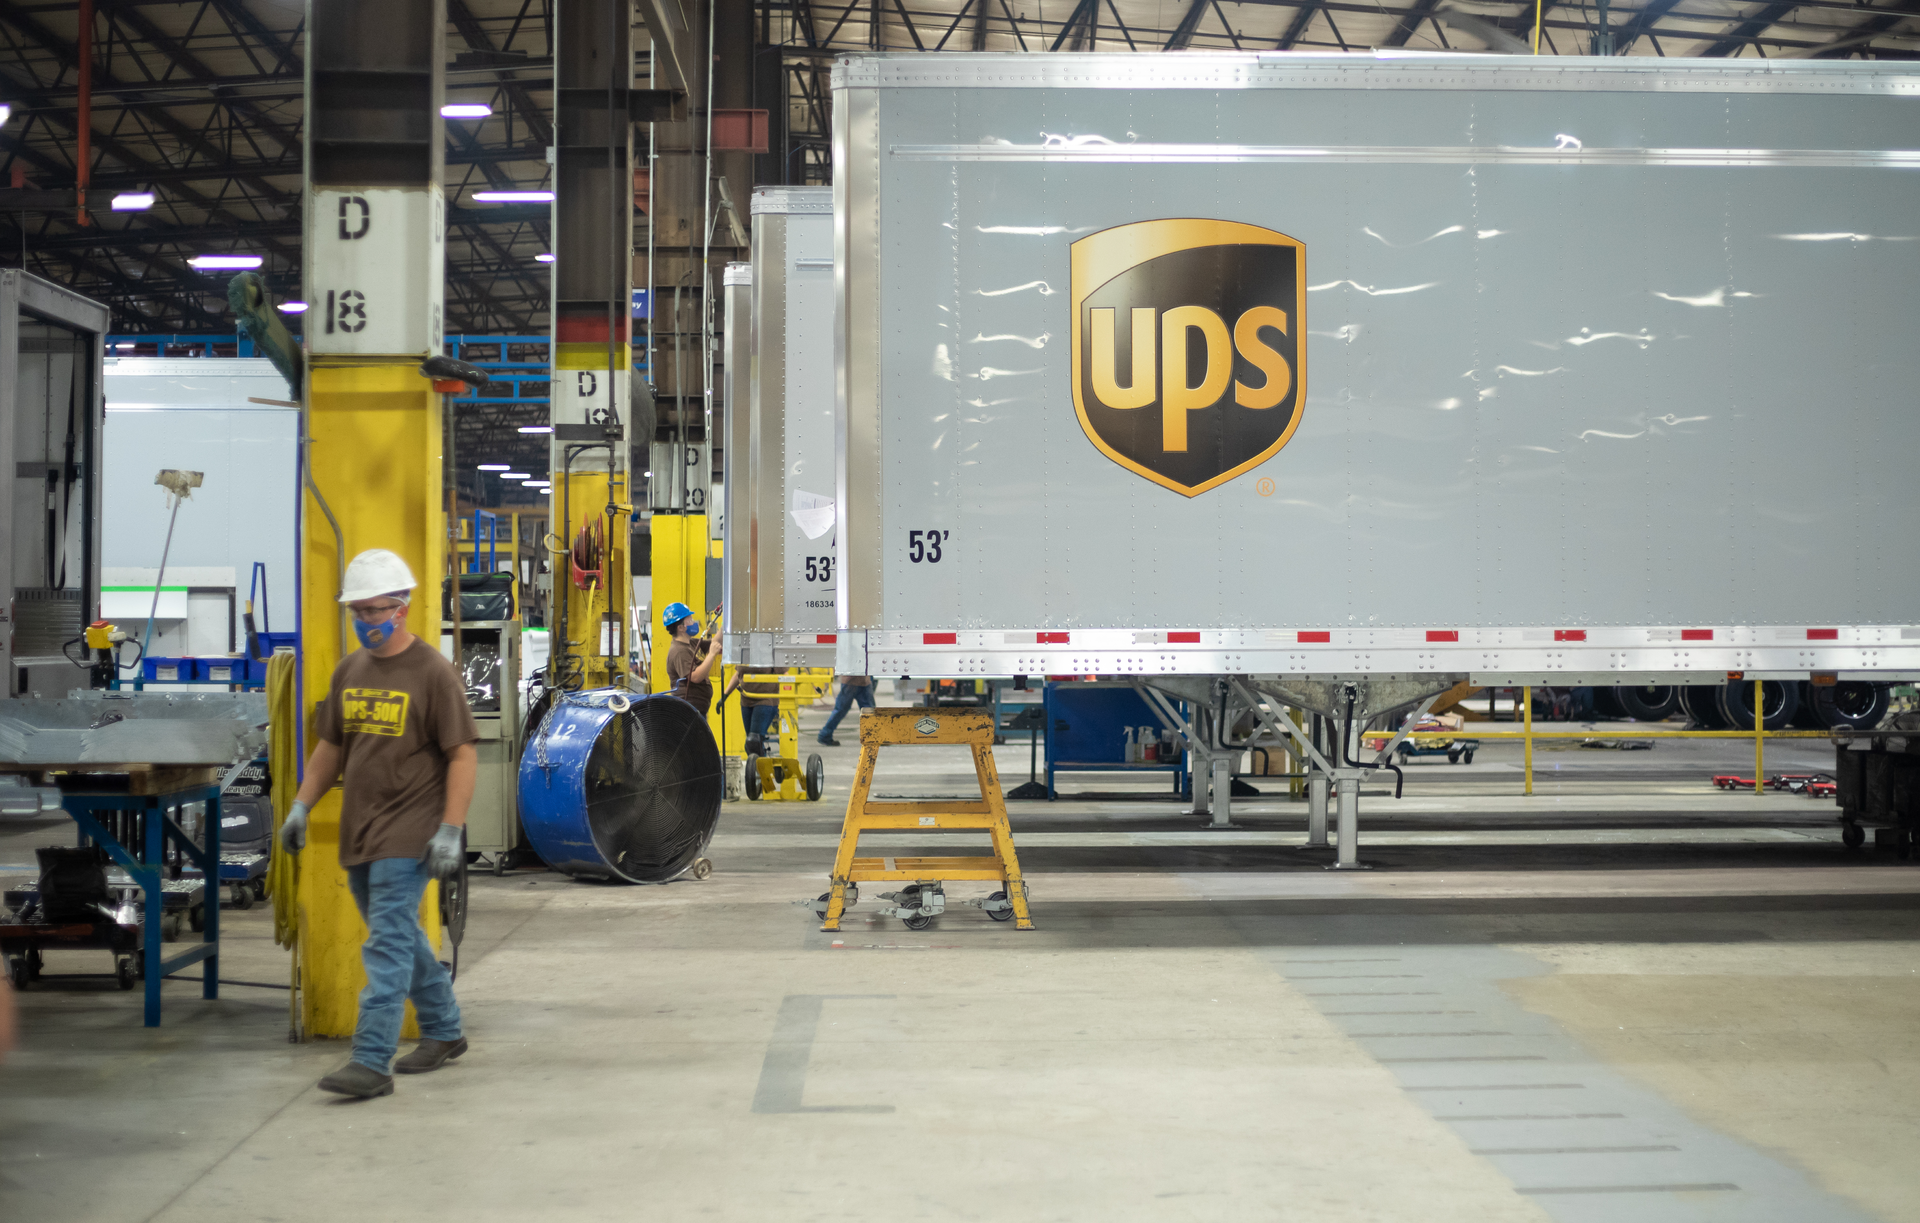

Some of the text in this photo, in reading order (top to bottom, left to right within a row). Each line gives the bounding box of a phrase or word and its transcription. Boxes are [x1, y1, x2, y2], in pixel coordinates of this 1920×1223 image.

[339, 196, 370, 240] D
[326, 289, 367, 334] 18
[578, 371, 597, 397] D
[1090, 305, 1292, 453] ups
[909, 530, 949, 563] 53'
[805, 600, 835, 608] 186334
[552, 723, 576, 740] L2
